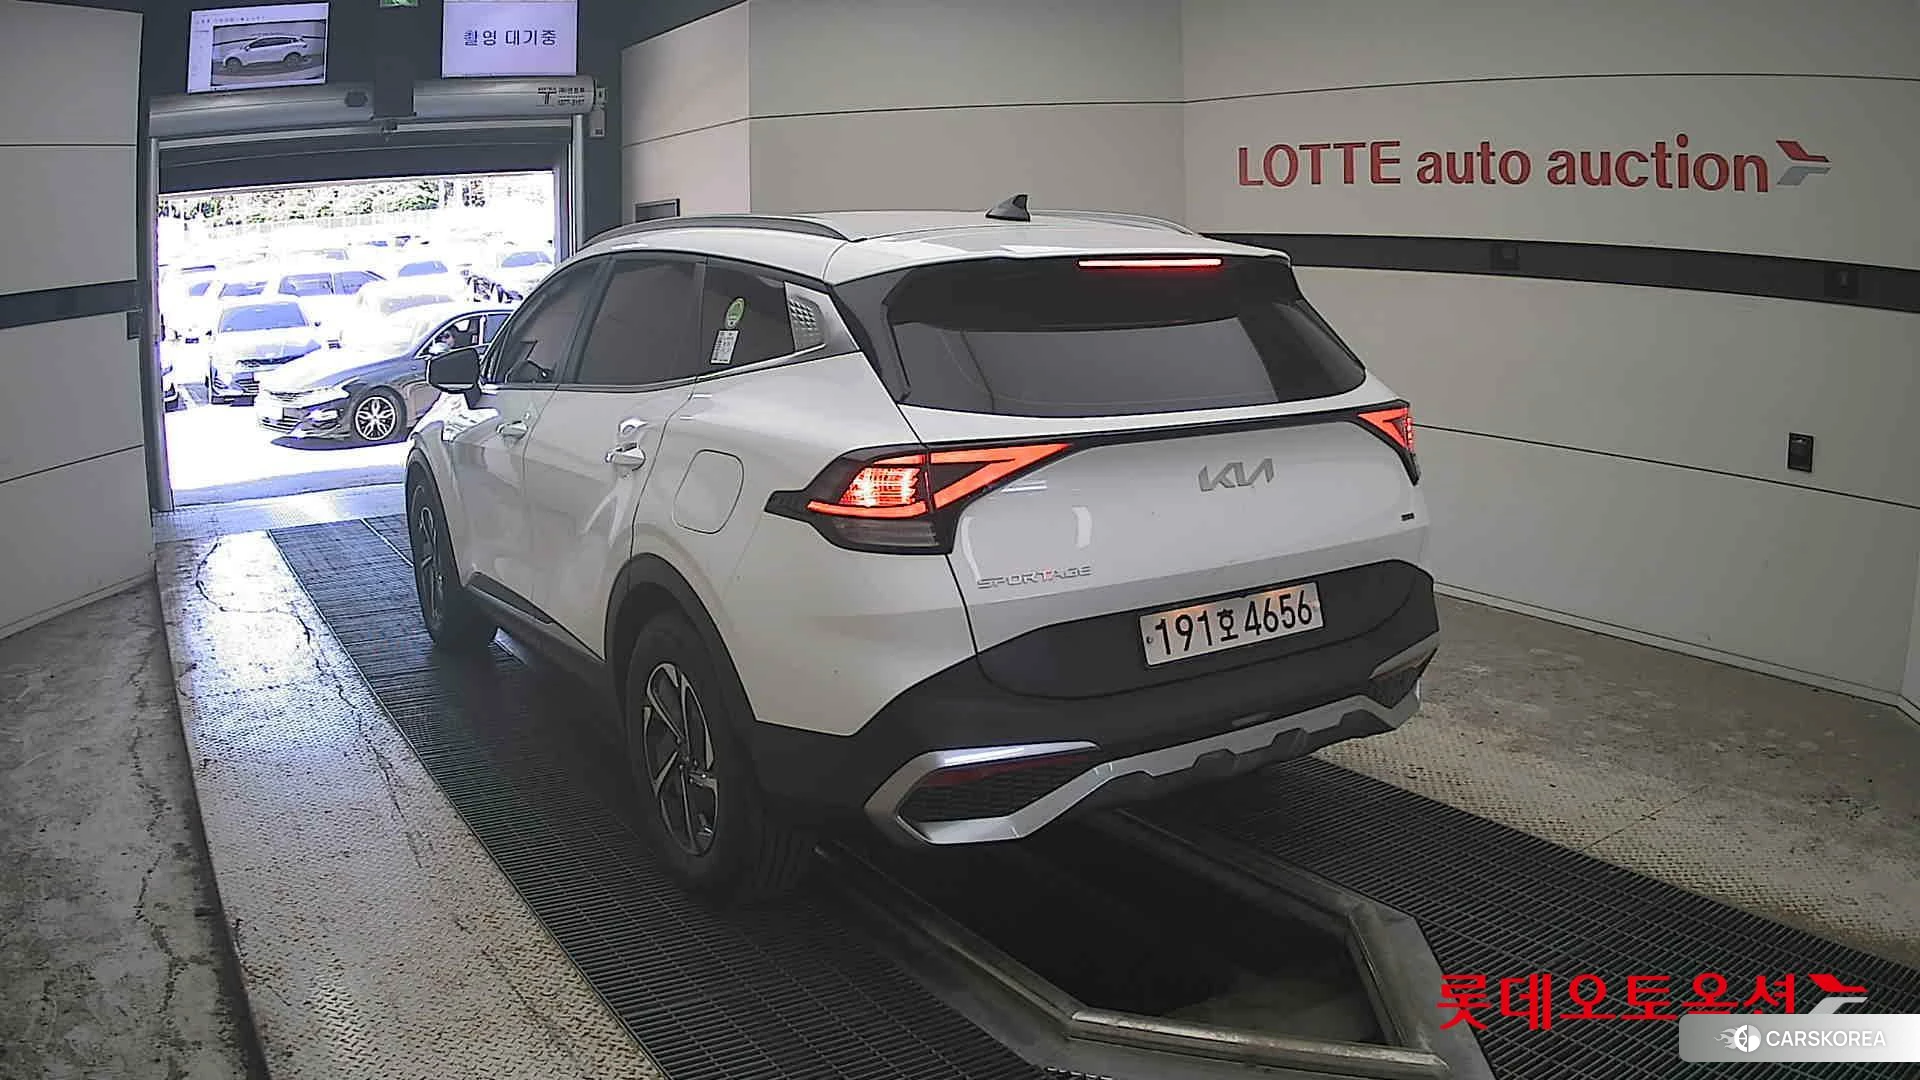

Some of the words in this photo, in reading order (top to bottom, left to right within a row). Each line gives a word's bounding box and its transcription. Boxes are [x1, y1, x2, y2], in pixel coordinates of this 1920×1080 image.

[505, 29, 557, 46] 대기중
[1238, 140, 1401, 188] LOTTE
[1415, 141, 1533, 186] auto
[1545, 132, 1770, 193] auction
[977, 565, 1092, 589] SPORTAGE
